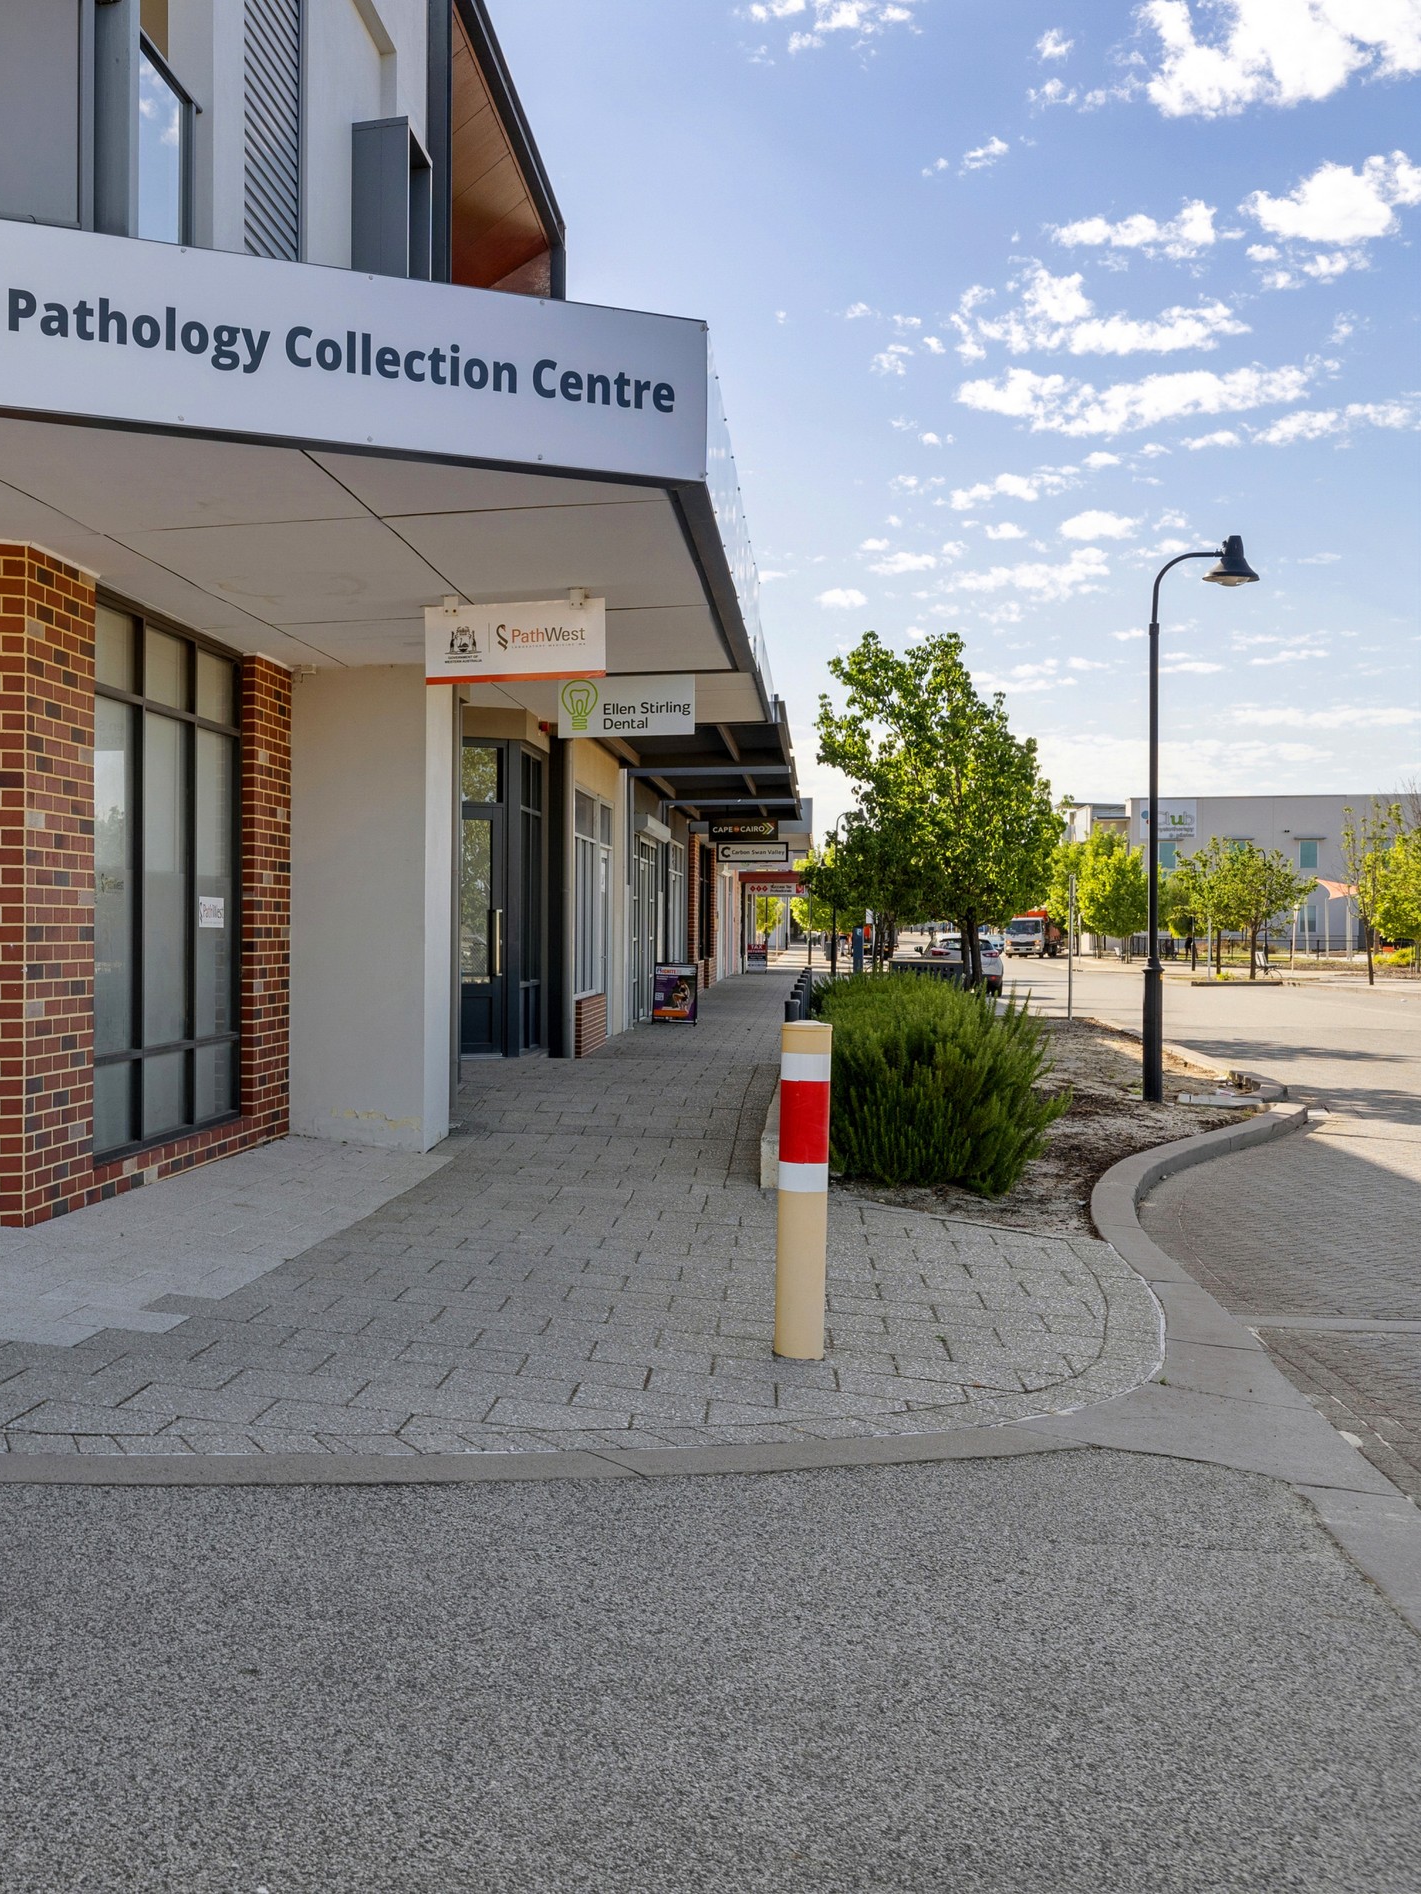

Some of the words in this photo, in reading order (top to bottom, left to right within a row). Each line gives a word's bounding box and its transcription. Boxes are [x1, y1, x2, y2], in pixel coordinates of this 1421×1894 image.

[7, 288, 271, 374] Pathology
[285, 326, 518, 394] Collection
[532, 359, 676, 413] Centre
[511, 626, 586, 644] PathWest
[602, 702, 636, 716] Ellen
[640, 700, 692, 719] Stirling
[602, 716, 649, 731] Dental
[203, 903, 224, 919] PathWest
